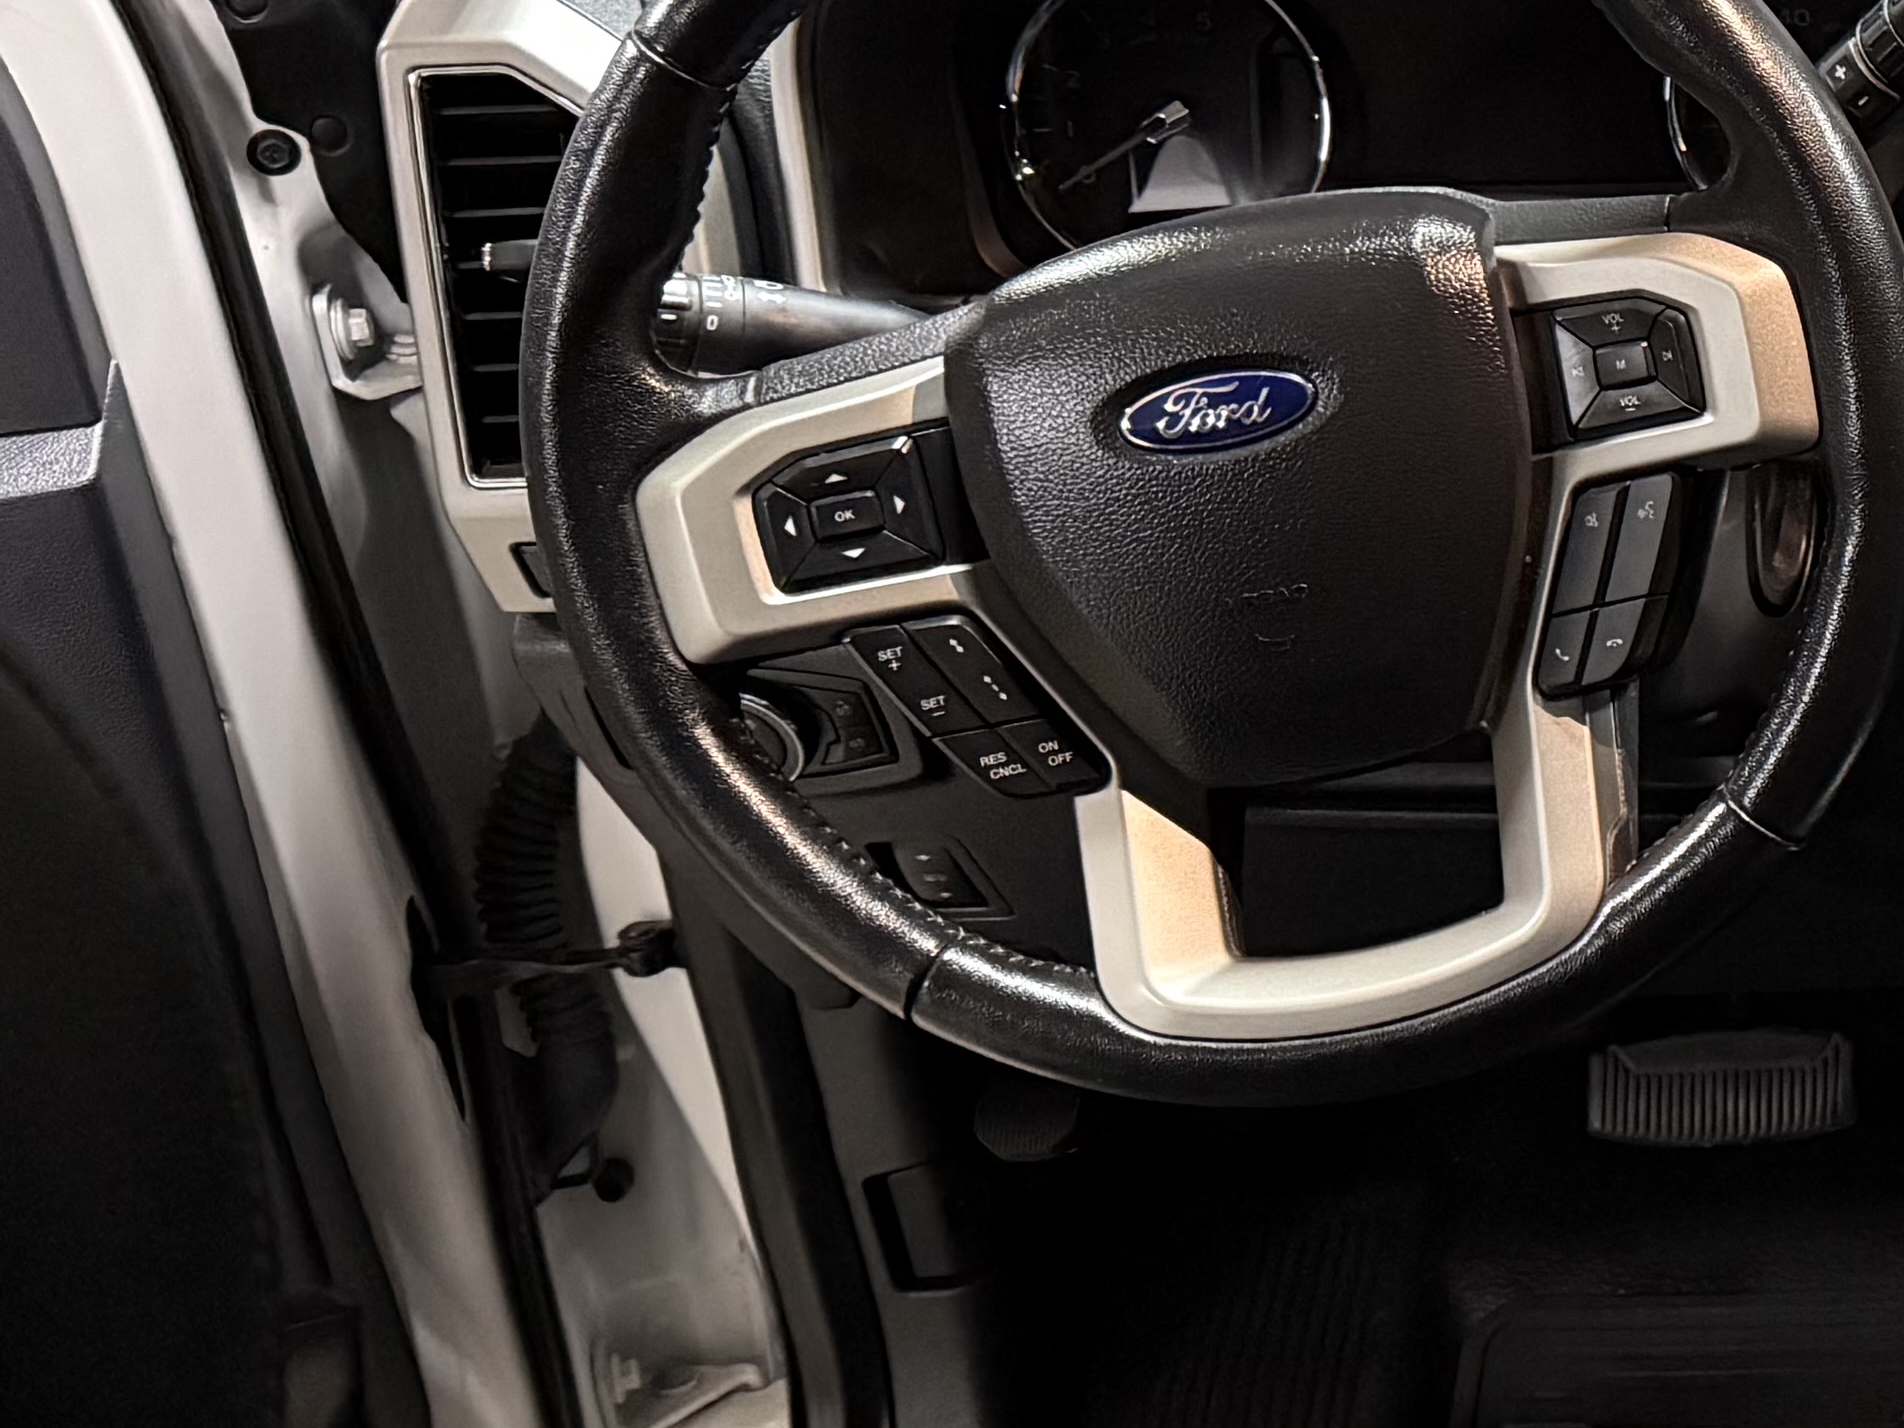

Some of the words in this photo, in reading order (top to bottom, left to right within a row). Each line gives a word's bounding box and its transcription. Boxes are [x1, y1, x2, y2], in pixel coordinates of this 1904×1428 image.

[1602, 311, 1625, 326] VOL
[1619, 394, 1642, 409] VOL
[1156, 381, 1272, 439] Ford
[834, 508, 856, 523] OK
[877, 646, 904, 662] SET
[920, 694, 946, 711] SET
[1038, 739, 1060, 755] ON
[979, 751, 1007, 768] RES
[1048, 751, 1074, 768] OFF
[989, 763, 1027, 781] CNCL
